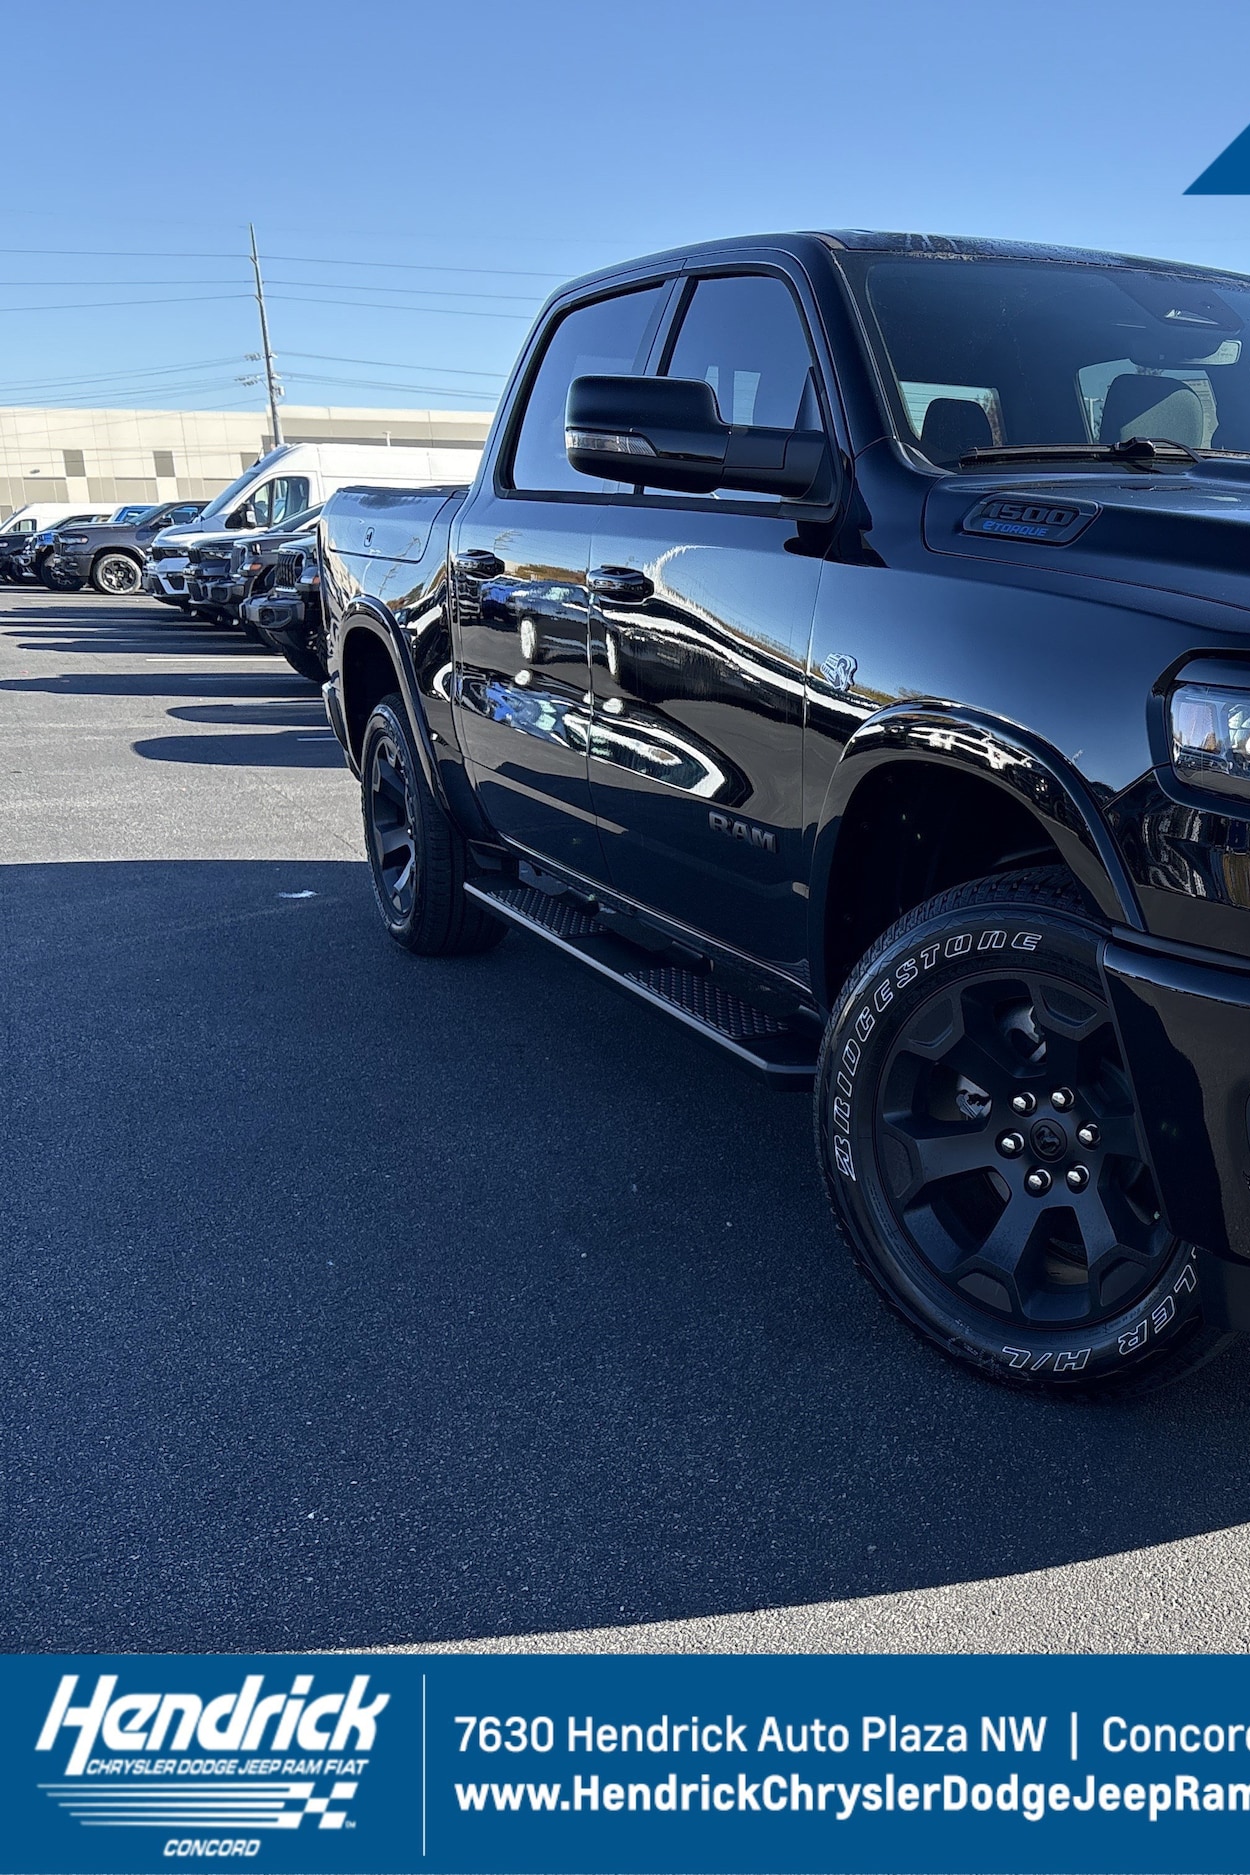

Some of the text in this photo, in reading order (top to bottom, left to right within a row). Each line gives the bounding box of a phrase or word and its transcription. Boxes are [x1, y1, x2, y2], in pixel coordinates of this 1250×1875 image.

[989, 502, 1075, 526] 1500
[708, 811, 777, 853] RAM
[833, 930, 1043, 1182] BRIDGESTONE
[1002, 1346, 1093, 1372] H/L
